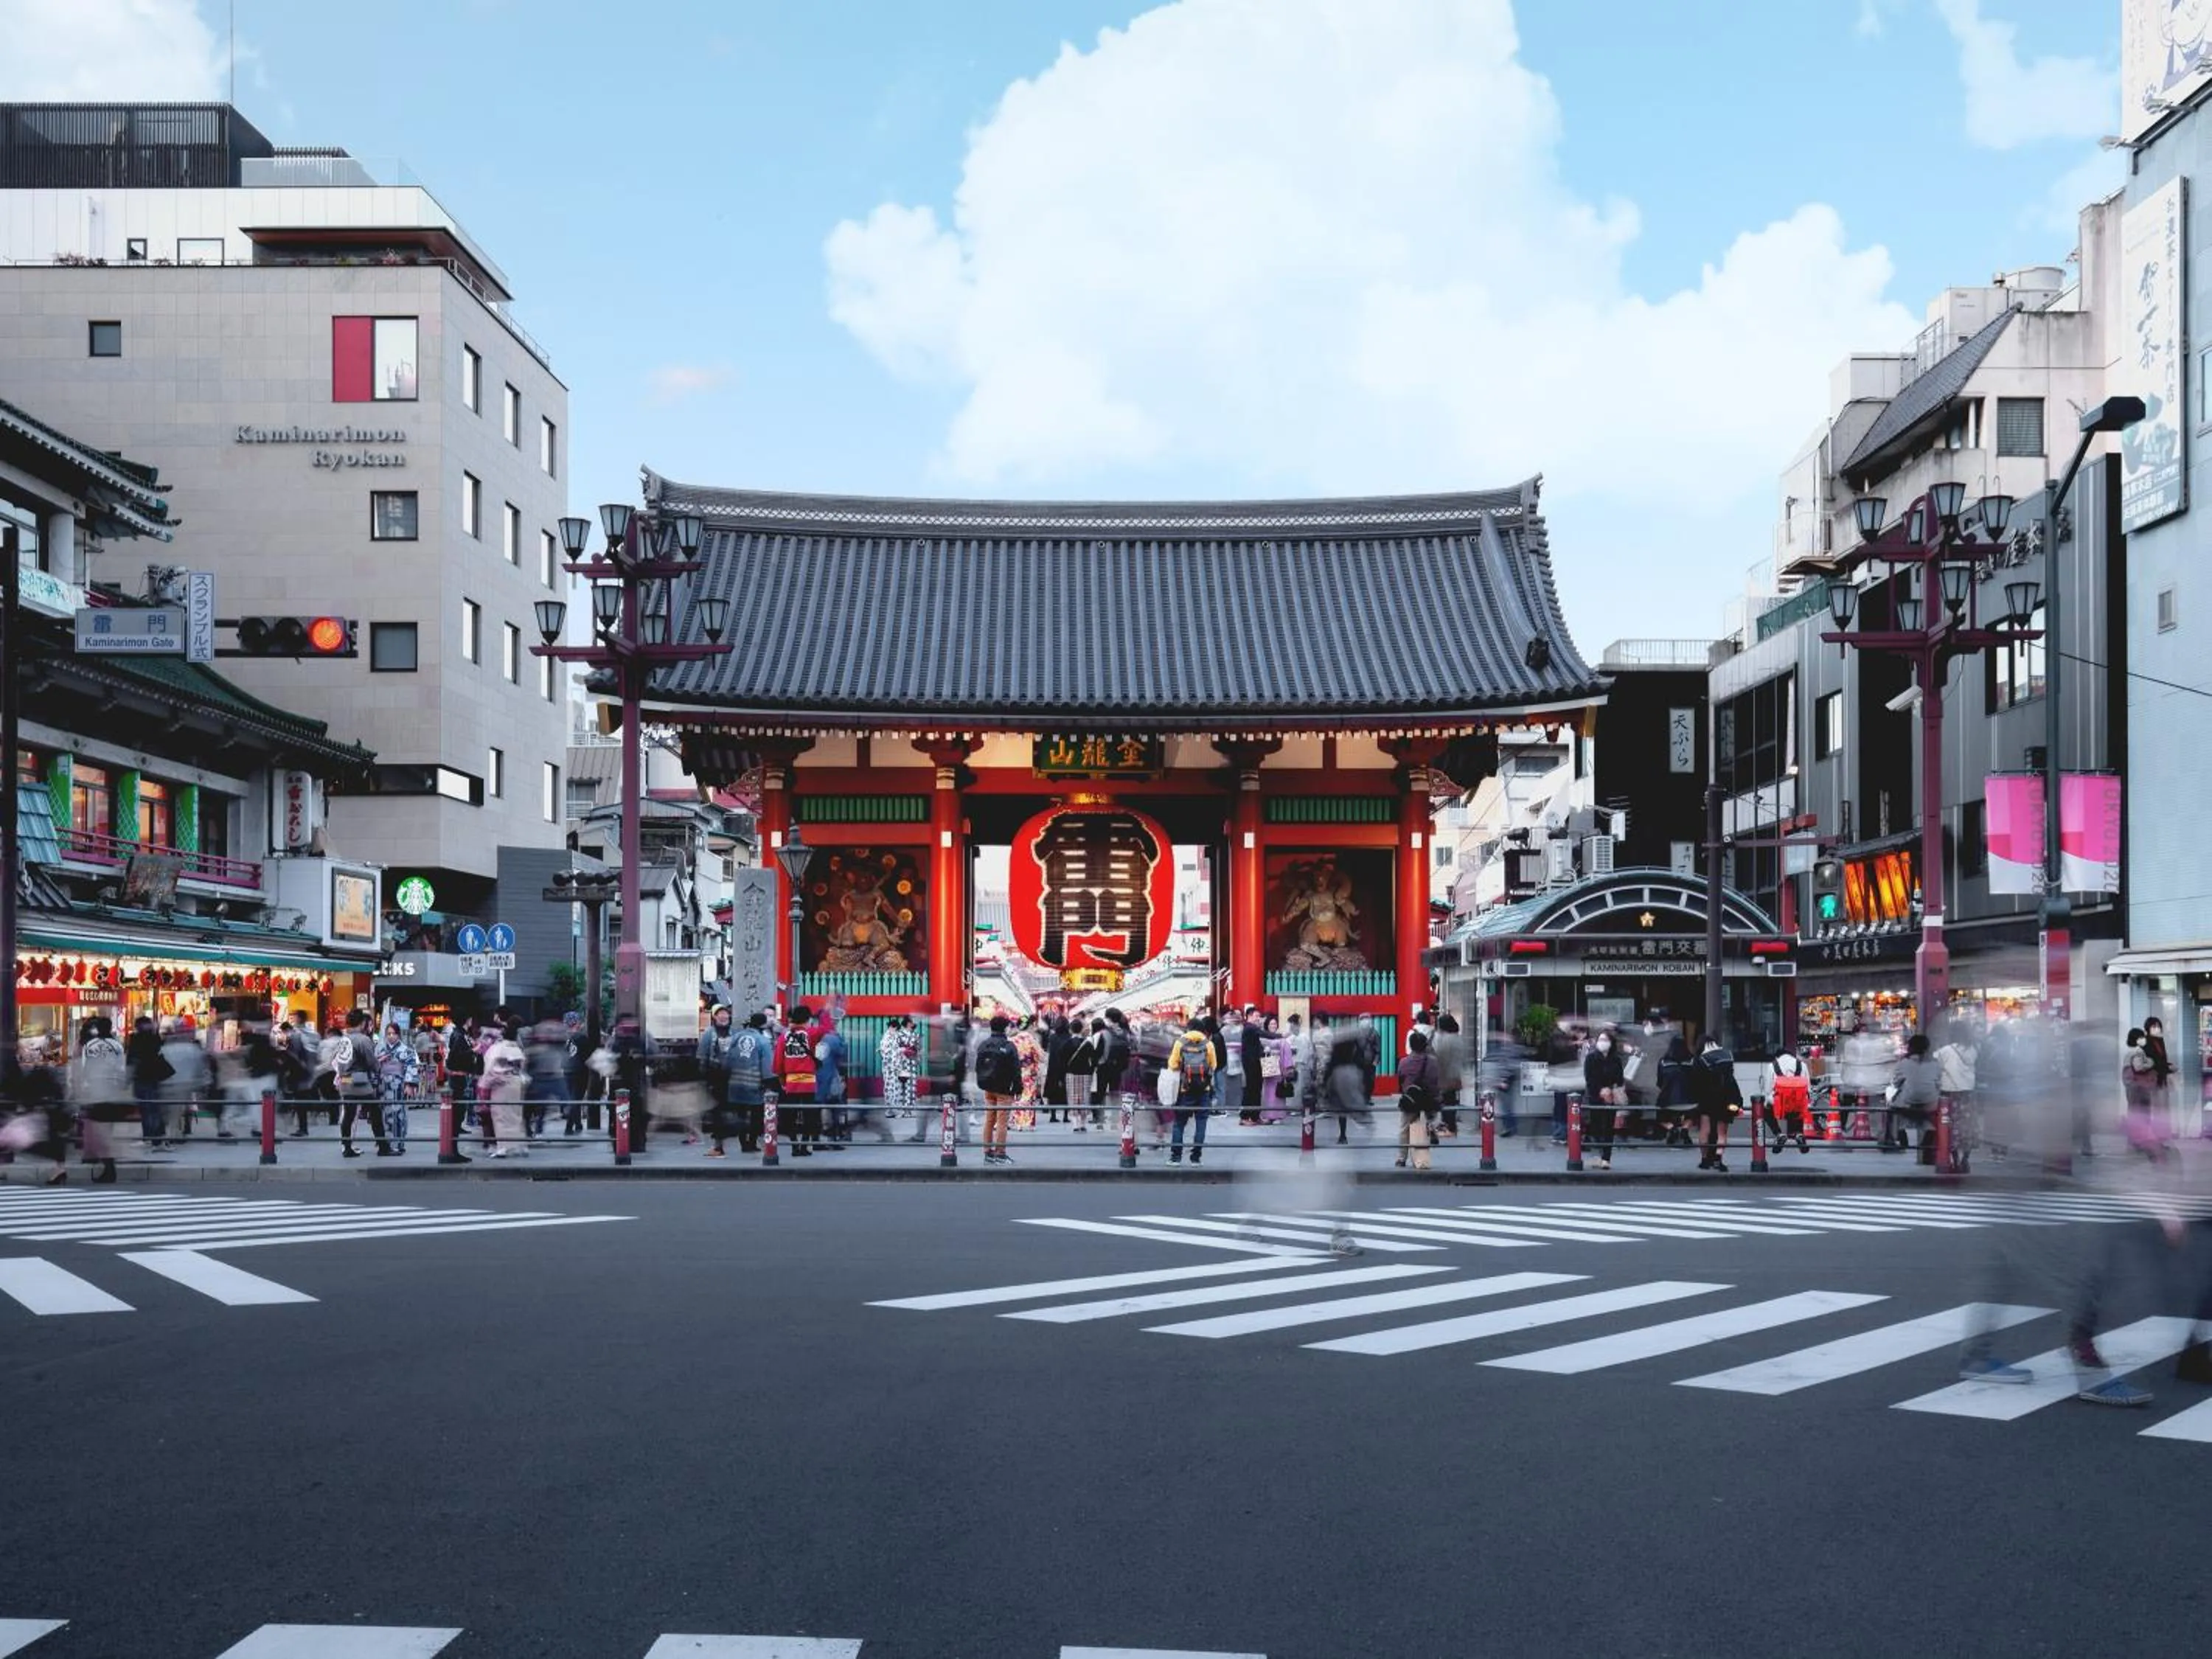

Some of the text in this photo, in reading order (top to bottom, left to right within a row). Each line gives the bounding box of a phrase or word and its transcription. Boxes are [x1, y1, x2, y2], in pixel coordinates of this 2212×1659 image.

[234, 425, 406, 444] Kaminarimon
[312, 449, 406, 472] Ryokan
[193, 575, 209, 658] スクランブル式
[85, 636, 175, 647] Kaminarimon Gate
[1672, 713, 1690, 766] 天ぷら
[1032, 810, 1162, 970] 雷門
[1590, 962, 1695, 973] KAMINARIMON KOBAN
